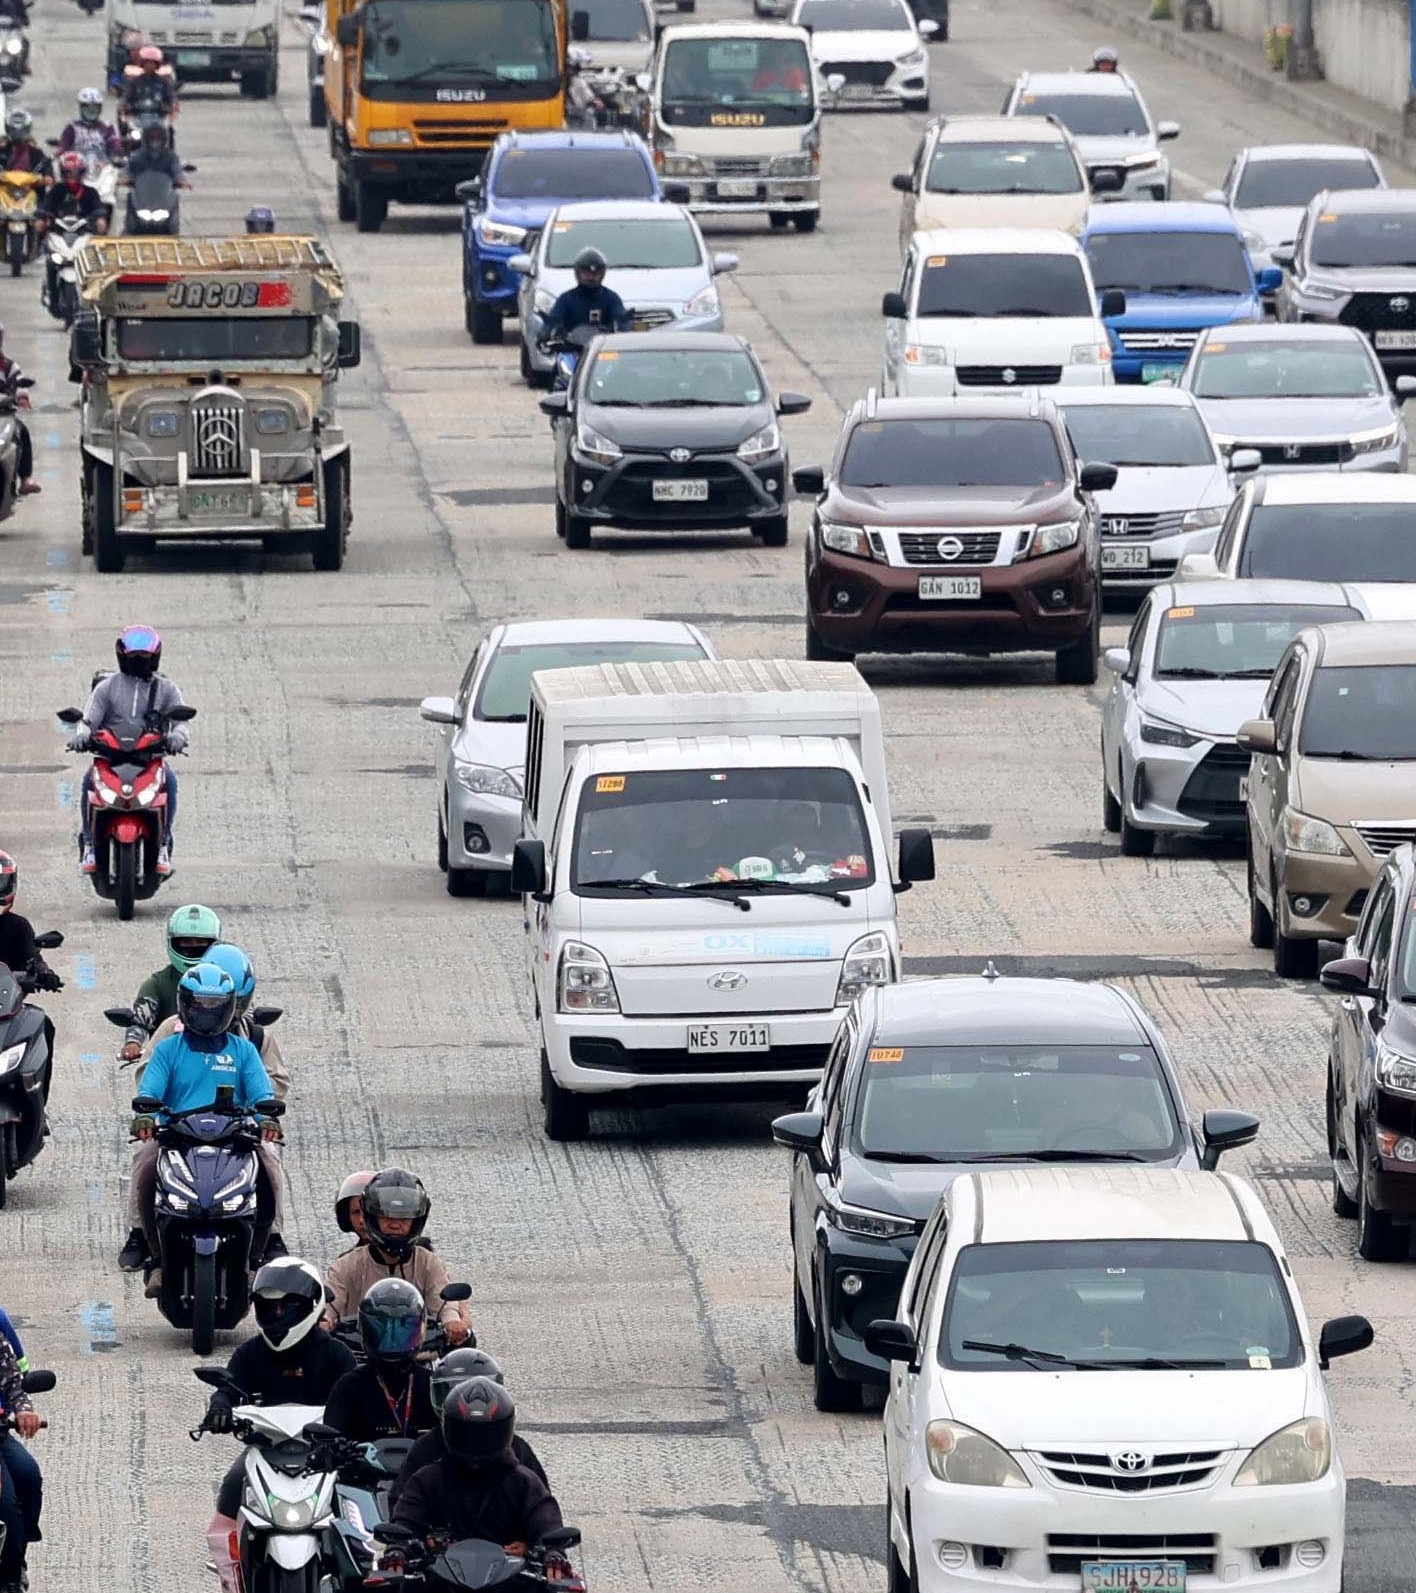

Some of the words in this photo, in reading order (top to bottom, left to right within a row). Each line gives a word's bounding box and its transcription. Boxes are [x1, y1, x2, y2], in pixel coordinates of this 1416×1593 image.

[436, 88, 486, 102] ISUZU
[168, 282, 259, 308] JACOB
[951, 582, 978, 594] 1012
[690, 1030, 718, 1047] NES
[729, 1029, 767, 1046] 7011
[1090, 1566, 1129, 1588] SJH
[1139, 1565, 1178, 1588] 928
